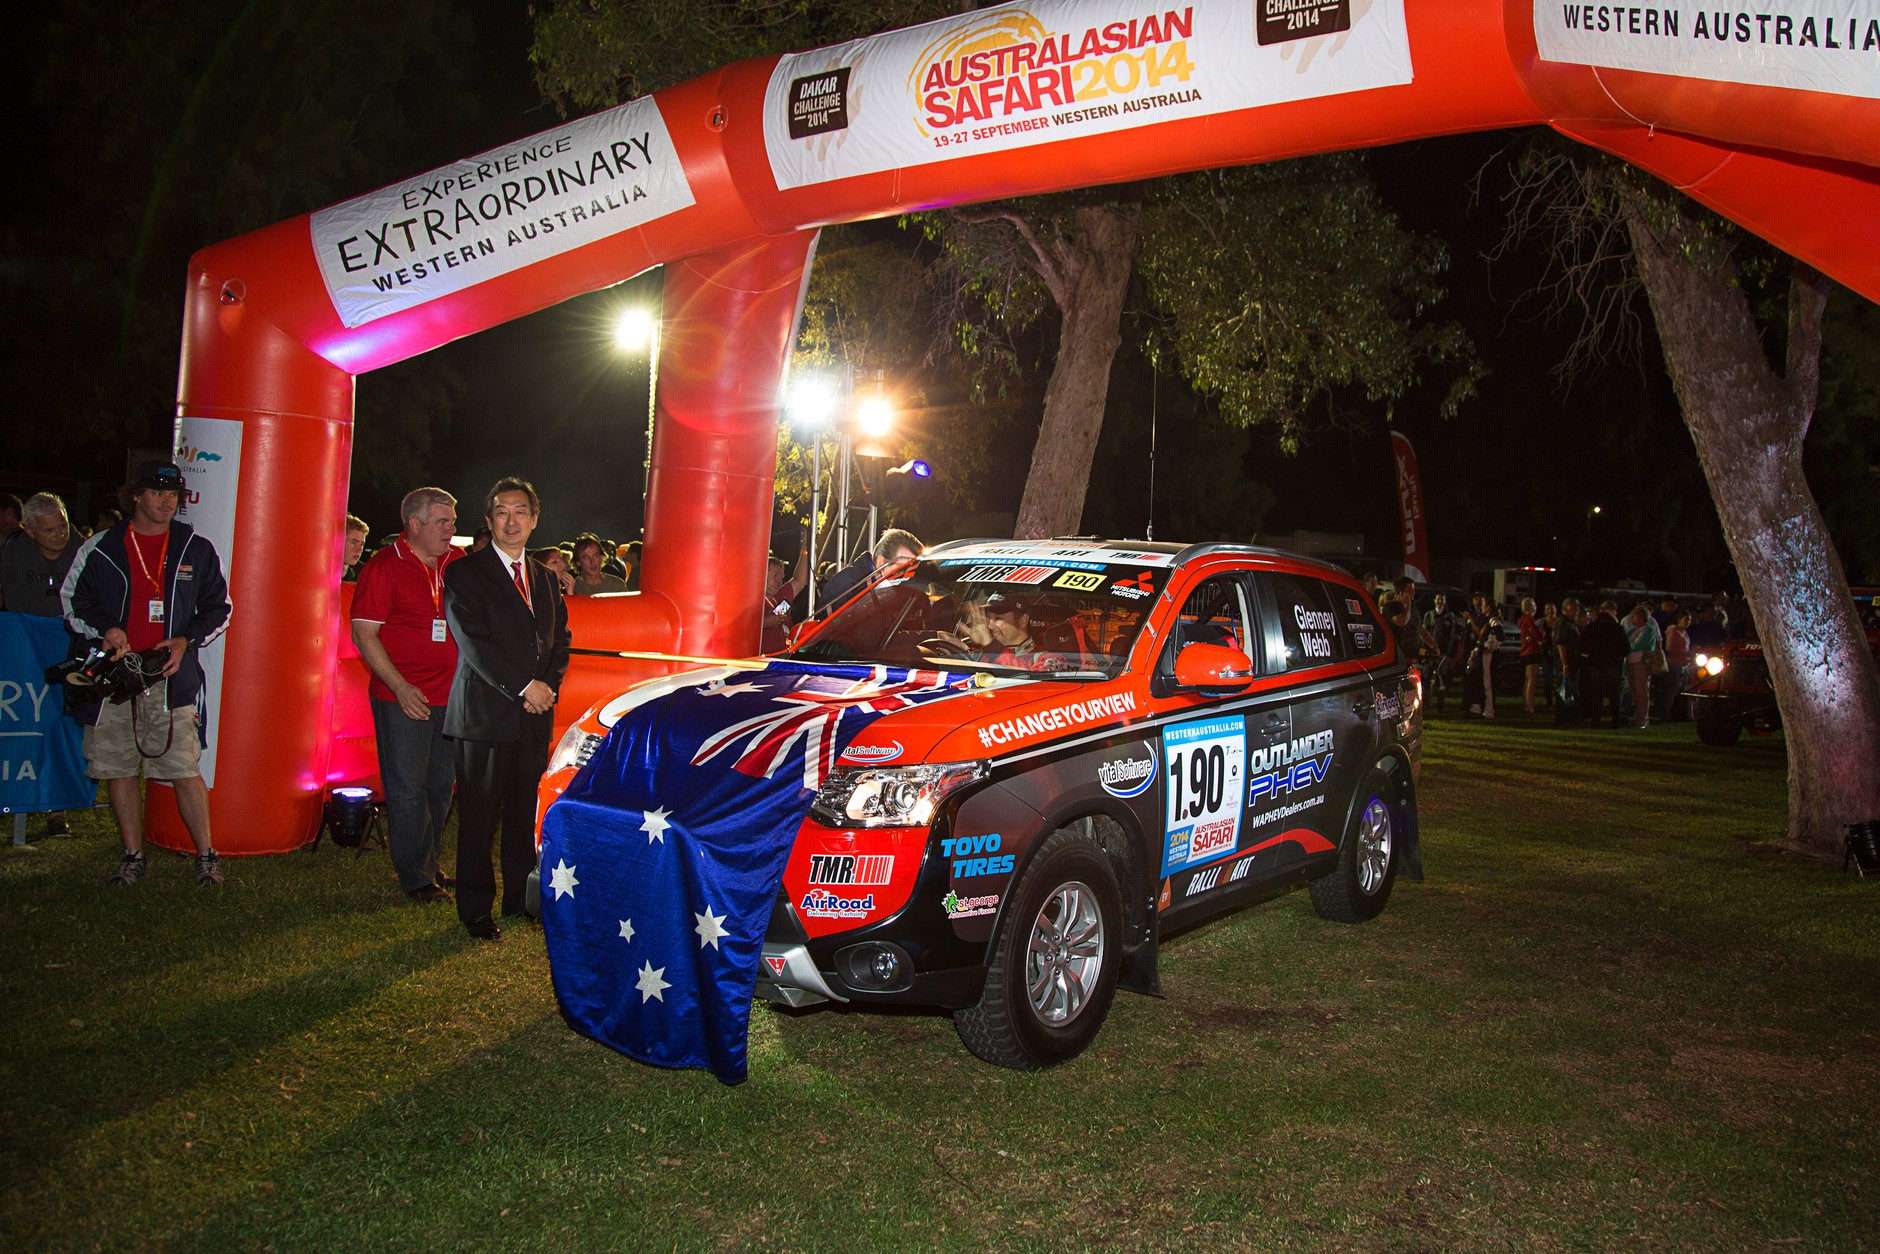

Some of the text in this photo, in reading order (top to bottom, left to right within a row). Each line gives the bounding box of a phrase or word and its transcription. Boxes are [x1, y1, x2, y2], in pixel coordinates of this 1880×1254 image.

[1287, 8, 1319, 30] 2014
[1563, 4, 1880, 51] WESTERN AUSTRALIA
[923, 7, 1193, 92] AUSTRALASIAN
[800, 76, 838, 100] DAKAR
[925, 41, 1195, 129] SAFARI 2014
[794, 92, 841, 115] CHALLENGE
[807, 110, 828, 128] 2014
[933, 88, 1202, 148] 19-27 SEPTEMBER WESTERN AUSTRALIA
[403, 136, 572, 210] EXPERIENCE
[337, 132, 654, 273] EXTRAORDINARY
[372, 184, 648, 293] WESTERN AUSTRALIA
[947, 559, 1100, 570] WESTERNAUSTRALIA.COM
[1051, 549, 1092, 557] ART
[956, 565, 1017, 582] TMR
[1064, 573, 1101, 590] 190
[1110, 584, 1151, 598] MITSUBISHI
[1111, 589, 1142, 601] MOTORS
[1294, 604, 1336, 636] Glenney
[1300, 632, 1331, 658] Webb
[977, 691, 1137, 748] #CHANGEYOURVIEW
[1165, 721, 1244, 741] WESTERNAUSTRALIA.COM
[843, 746, 897, 756] italSoftware
[1251, 729, 1334, 775] OUTLANDER
[1098, 758, 1152, 784] vitalSoftware
[1170, 744, 1225, 822] 1.90
[1248, 753, 1334, 807] PHEV
[1252, 795, 1324, 829] WAPHEVDealers.com.au
[1169, 830, 1189, 847] 2014
[1194, 817, 1236, 835] AUSTRALASIAN
[941, 833, 1001, 857] TOYO
[1192, 825, 1235, 853] SAFARI
[809, 855, 856, 884] TMR
[952, 854, 1016, 878] TIRES
[1186, 856, 1255, 896] RALLI ART
[801, 894, 873, 910] AirRoad
[807, 909, 867, 920] Delivering Certainty
